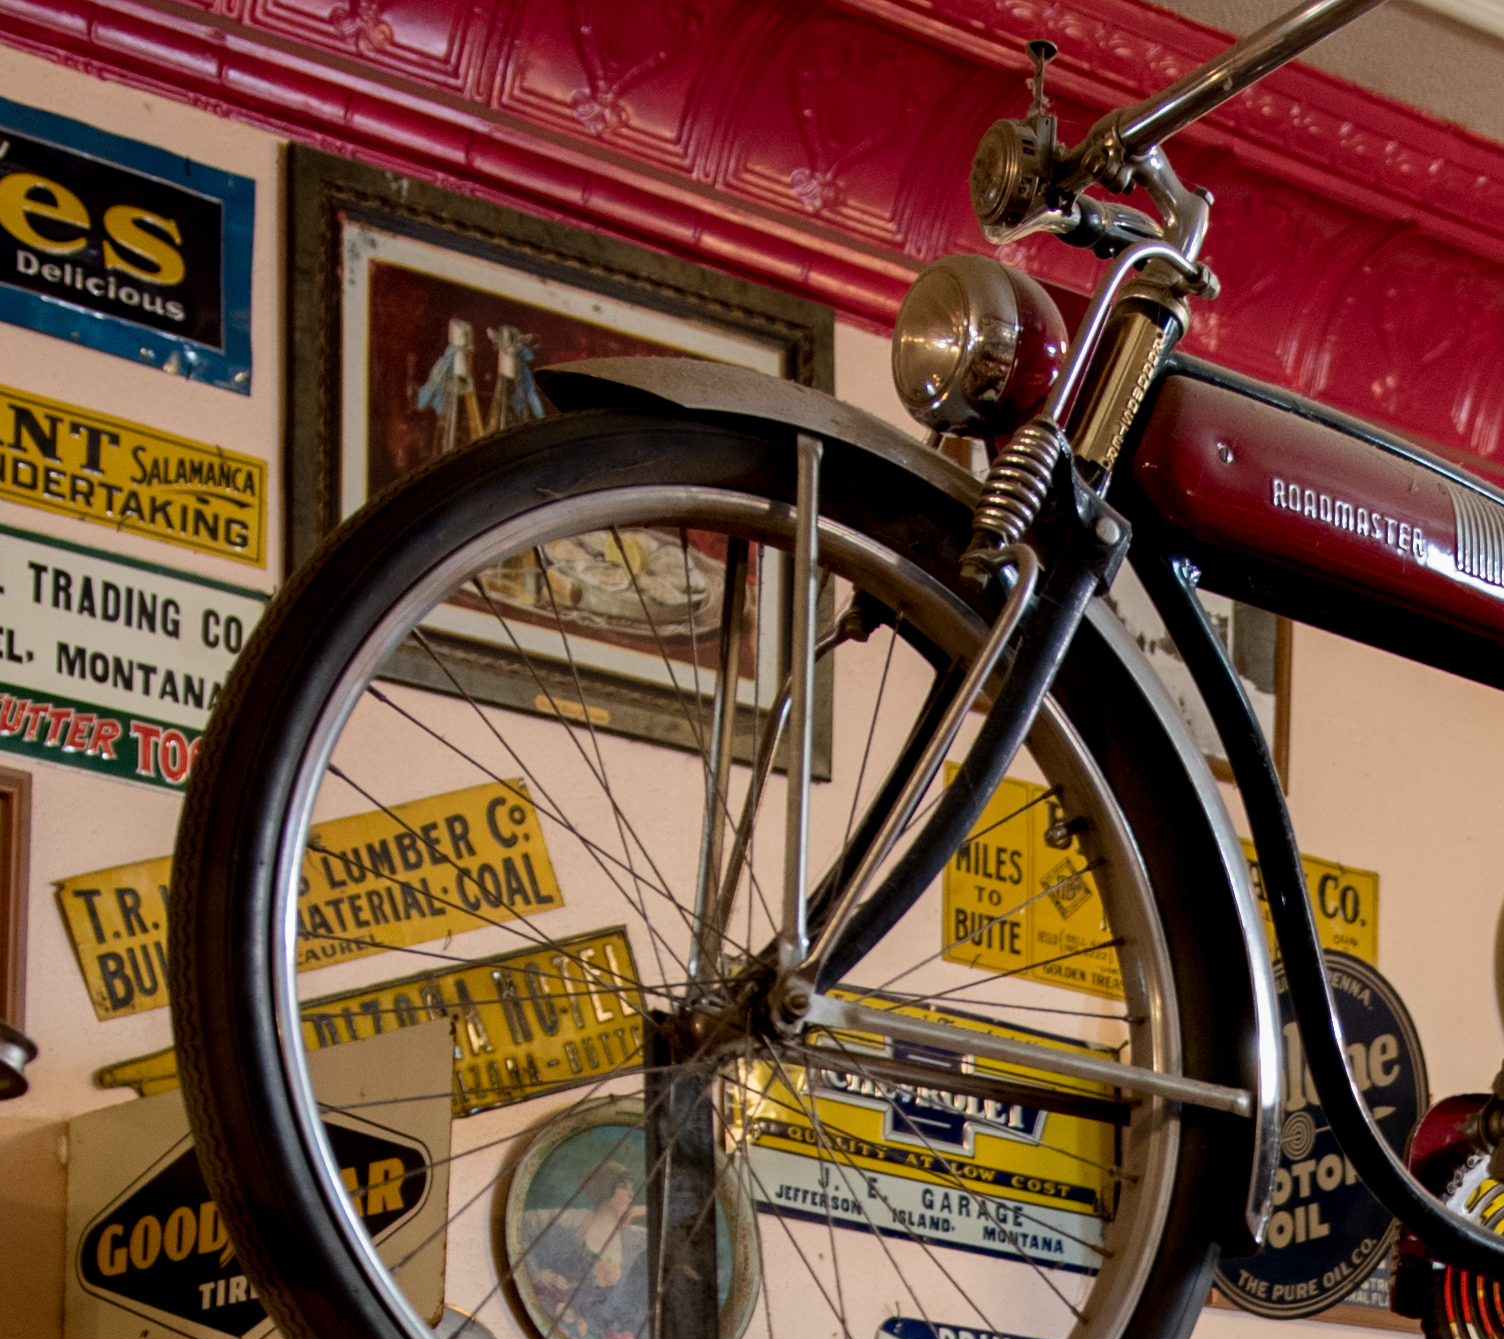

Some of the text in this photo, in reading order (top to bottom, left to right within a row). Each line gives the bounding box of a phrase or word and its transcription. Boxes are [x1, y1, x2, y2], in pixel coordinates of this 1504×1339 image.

[15, 249, 187, 323] Delicious
[1272, 478, 1426, 560] ROADMASTER
[29, 561, 180, 639] TRADING
[322, 814, 475, 890] LUMBER
[456, 854, 553, 914] COAL
[957, 841, 1022, 885] MILES
[975, 886, 1001, 906] TO
[955, 908, 1021, 955] BUTTE
[491, 944, 638, 1044] HOTEL
[787, 1126, 1070, 1199] QUALITY AT LOW COST
[775, 1184, 862, 1215] JEFFERSON
[983, 1227, 1064, 1254] MONTANA
[922, 1189, 1023, 1227] GARAGE
[1268, 1202, 1330, 1251] OIL
[1238, 1269, 1271, 1299] THE
[1271, 1275, 1318, 1302] PURE
[1321, 1261, 1353, 1290] OIL
